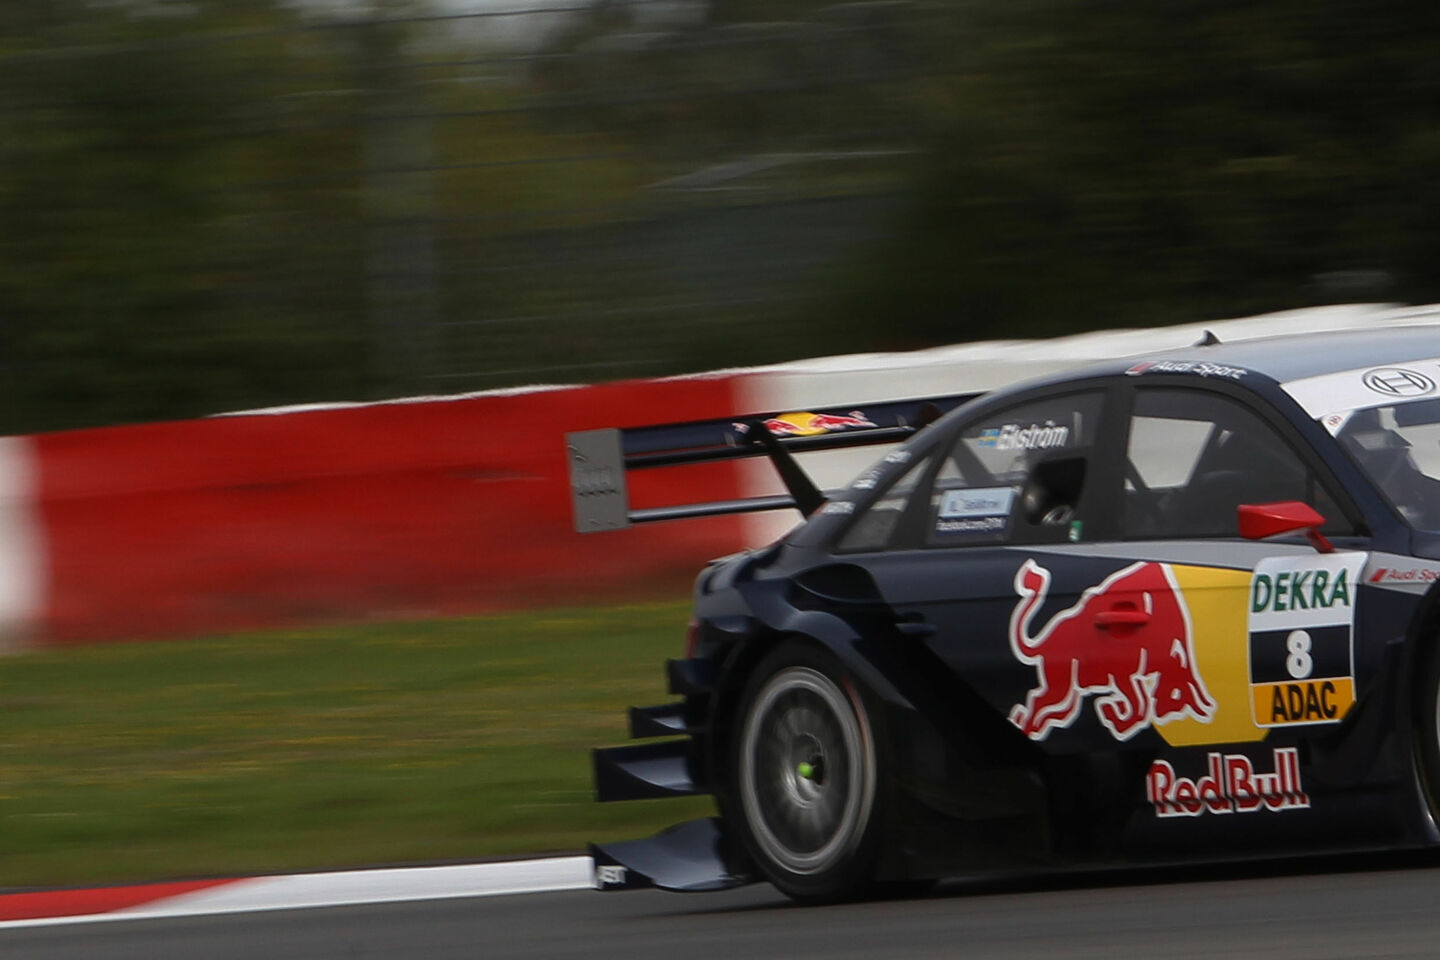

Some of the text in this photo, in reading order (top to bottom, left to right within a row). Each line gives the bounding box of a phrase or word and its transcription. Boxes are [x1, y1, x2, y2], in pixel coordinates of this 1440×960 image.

[1252, 568, 1350, 613] DEKRA
[1286, 630, 1313, 679] 8
[1272, 681, 1338, 723] ADAC
